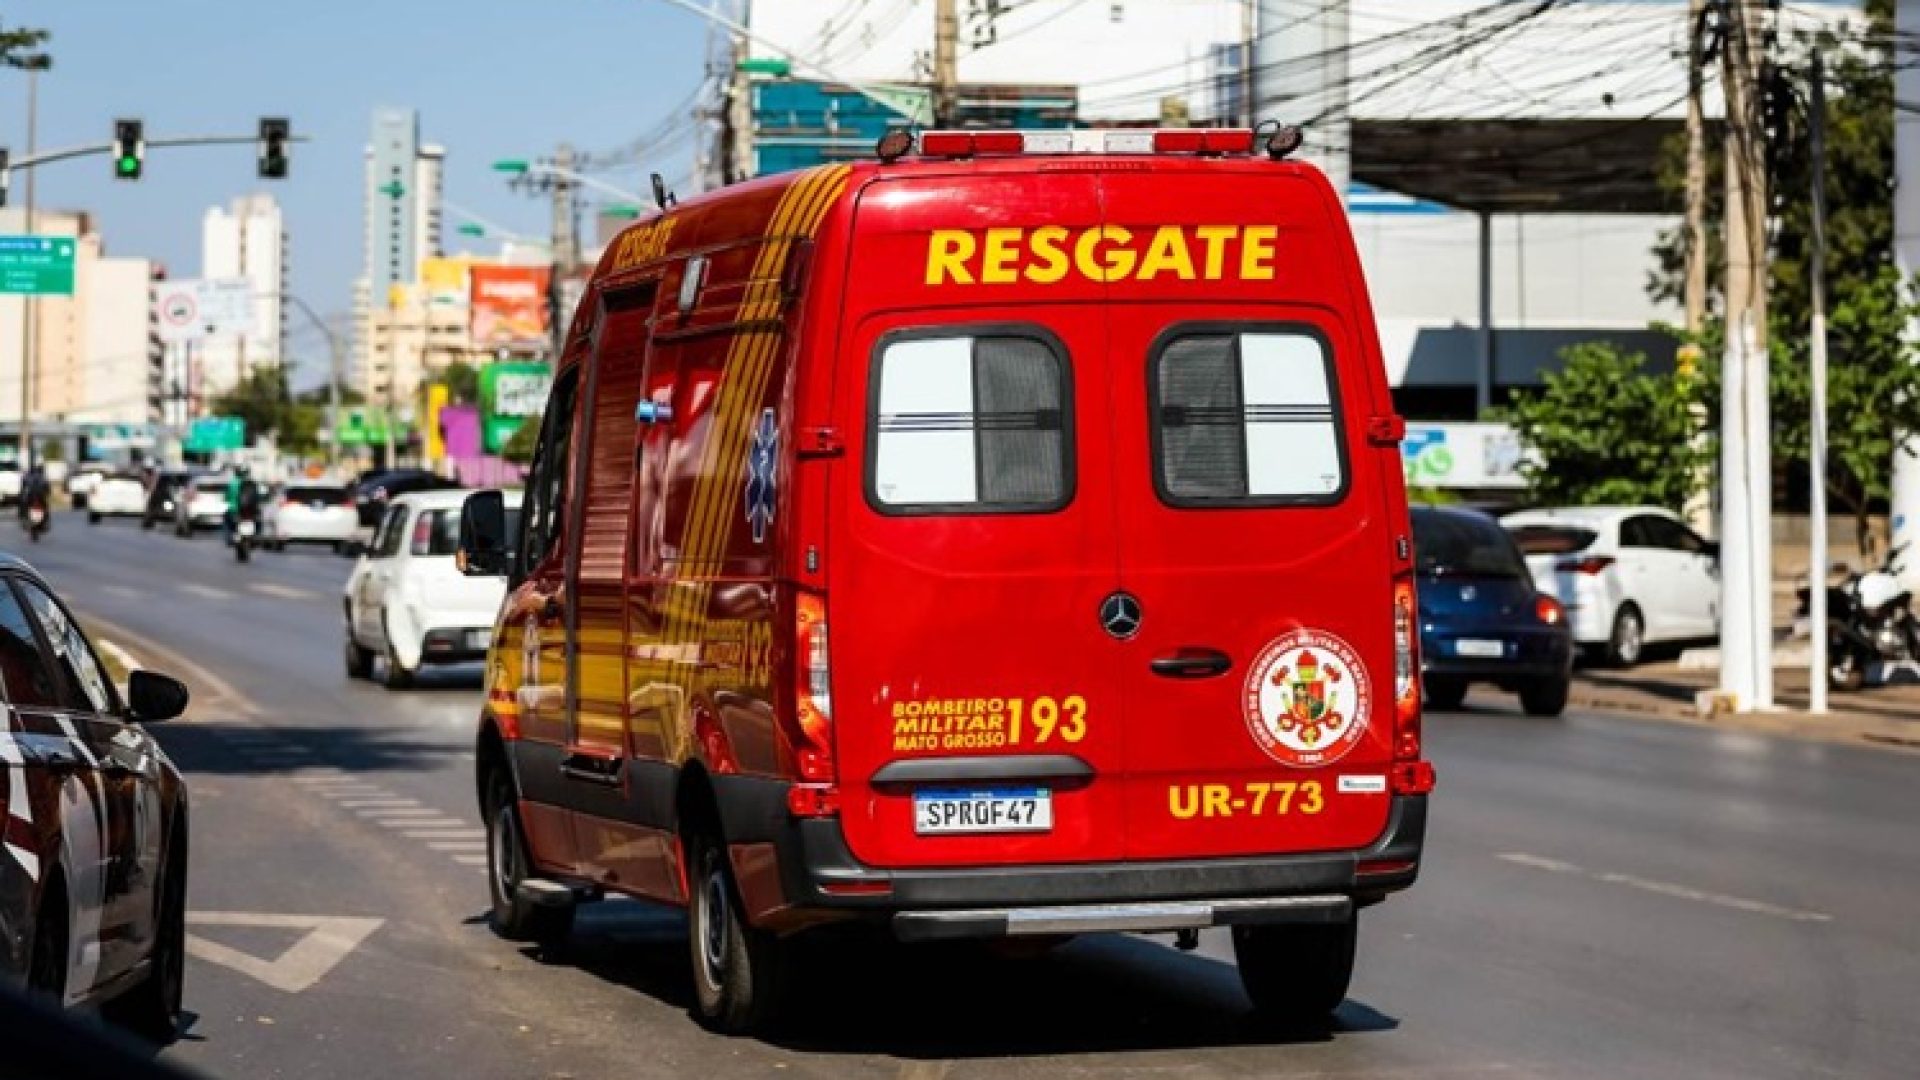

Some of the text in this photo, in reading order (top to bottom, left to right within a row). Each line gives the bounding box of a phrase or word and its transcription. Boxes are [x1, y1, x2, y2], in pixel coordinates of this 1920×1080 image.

[925, 225, 1278, 285] RESGATE
[892, 699, 1006, 718] BOMBEIRO
[1006, 695, 1087, 744] 193
[894, 715, 1005, 734] MILITAR
[893, 732, 1005, 750] MATO GROSSO
[1169, 780, 1324, 819] UR-773
